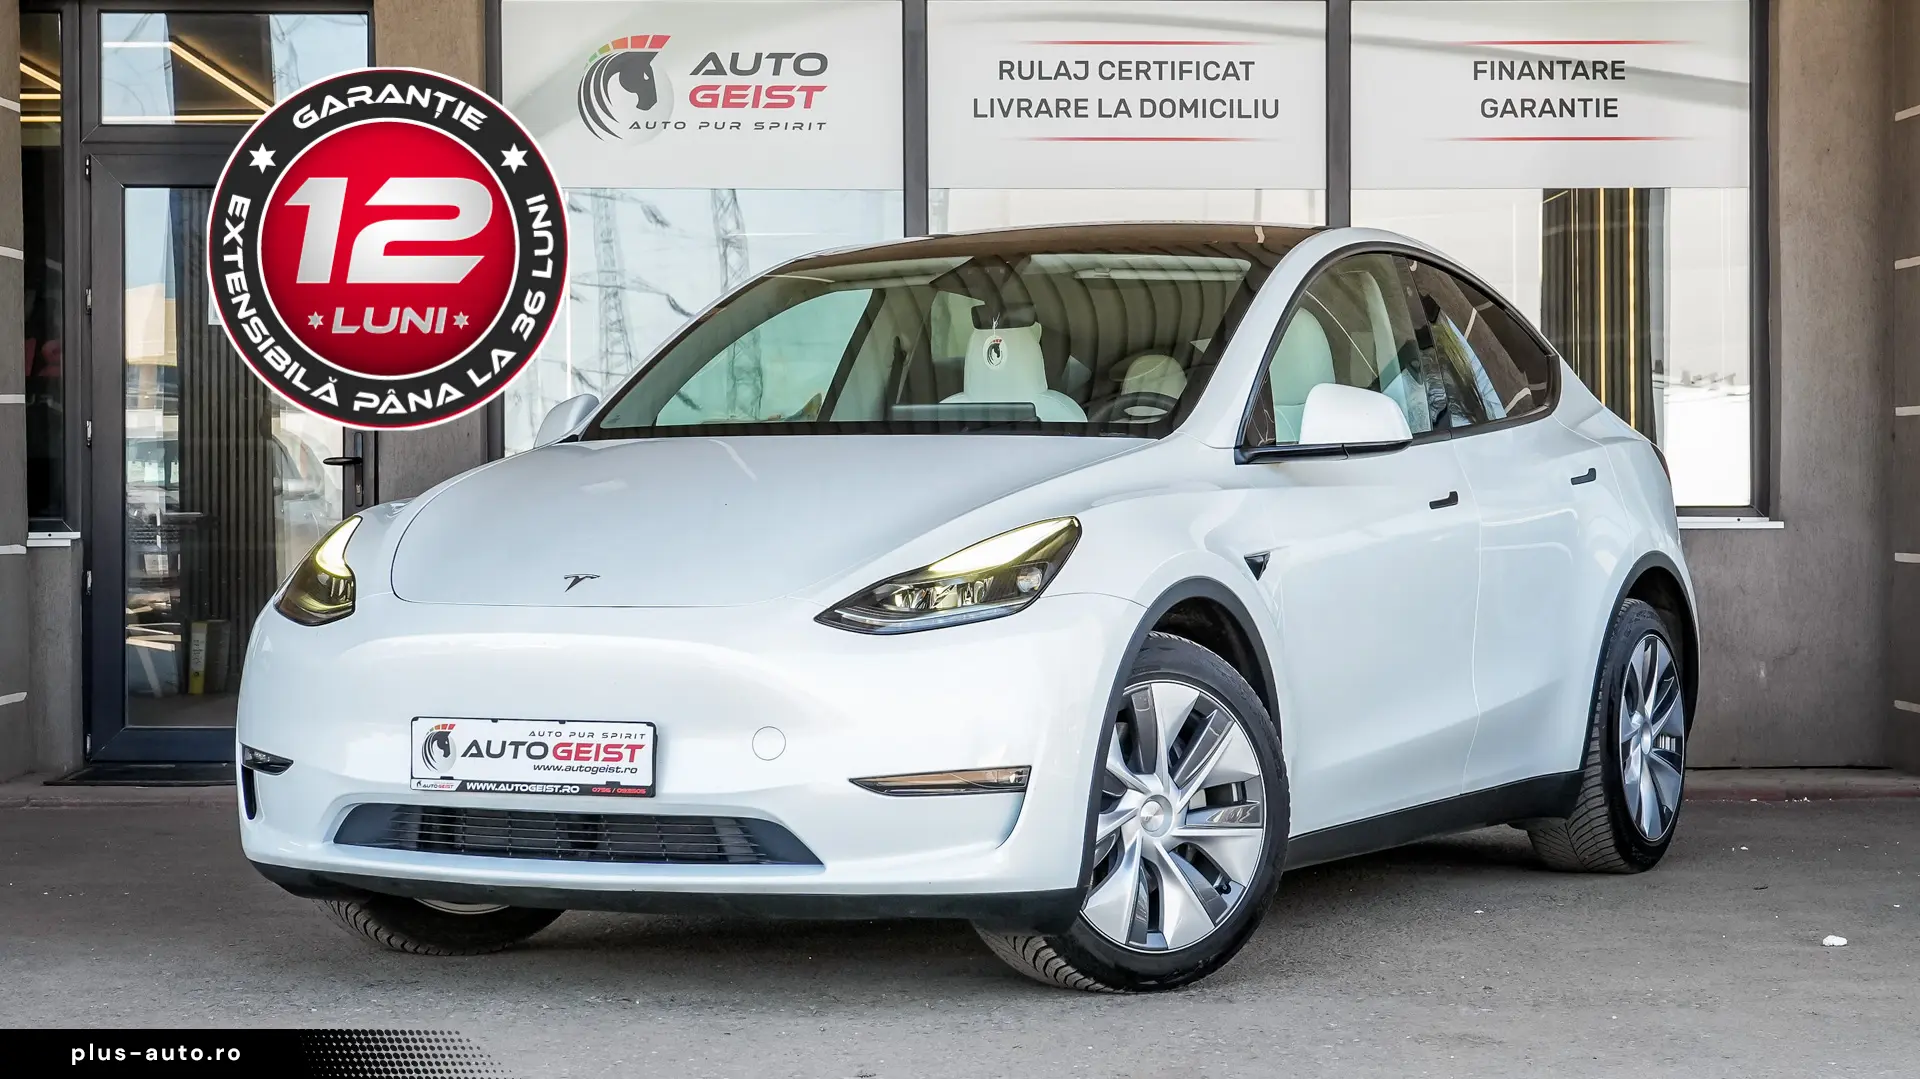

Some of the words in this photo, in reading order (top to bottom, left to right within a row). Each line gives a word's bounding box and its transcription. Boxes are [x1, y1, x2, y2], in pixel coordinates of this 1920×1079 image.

[689, 51, 829, 77] AUTO
[999, 60, 1090, 81] RULAJ
[1098, 60, 1255, 81] CERTIFICAT
[1473, 60, 1626, 81] FINANTARE
[688, 84, 828, 109] GEIST
[973, 98, 1089, 119] LIVRARE
[1098, 98, 1132, 119] LA
[1140, 98, 1279, 119] DOMICILIU
[1480, 98, 1619, 119] GARANTIE
[629, 121, 687, 130] AUTO
[698, 121, 742, 131] PUR
[753, 121, 827, 131] SPIRIT
[528, 730, 562, 738] AUTO
[568, 731, 595, 739] PUR
[601, 731, 646, 740] SPIRIT
[460, 739, 646, 763] AUTOGEIST
[533, 763, 638, 775] www.autogeist.ro
[466, 781, 580, 794] WWW.AUTOGEIST.RO
